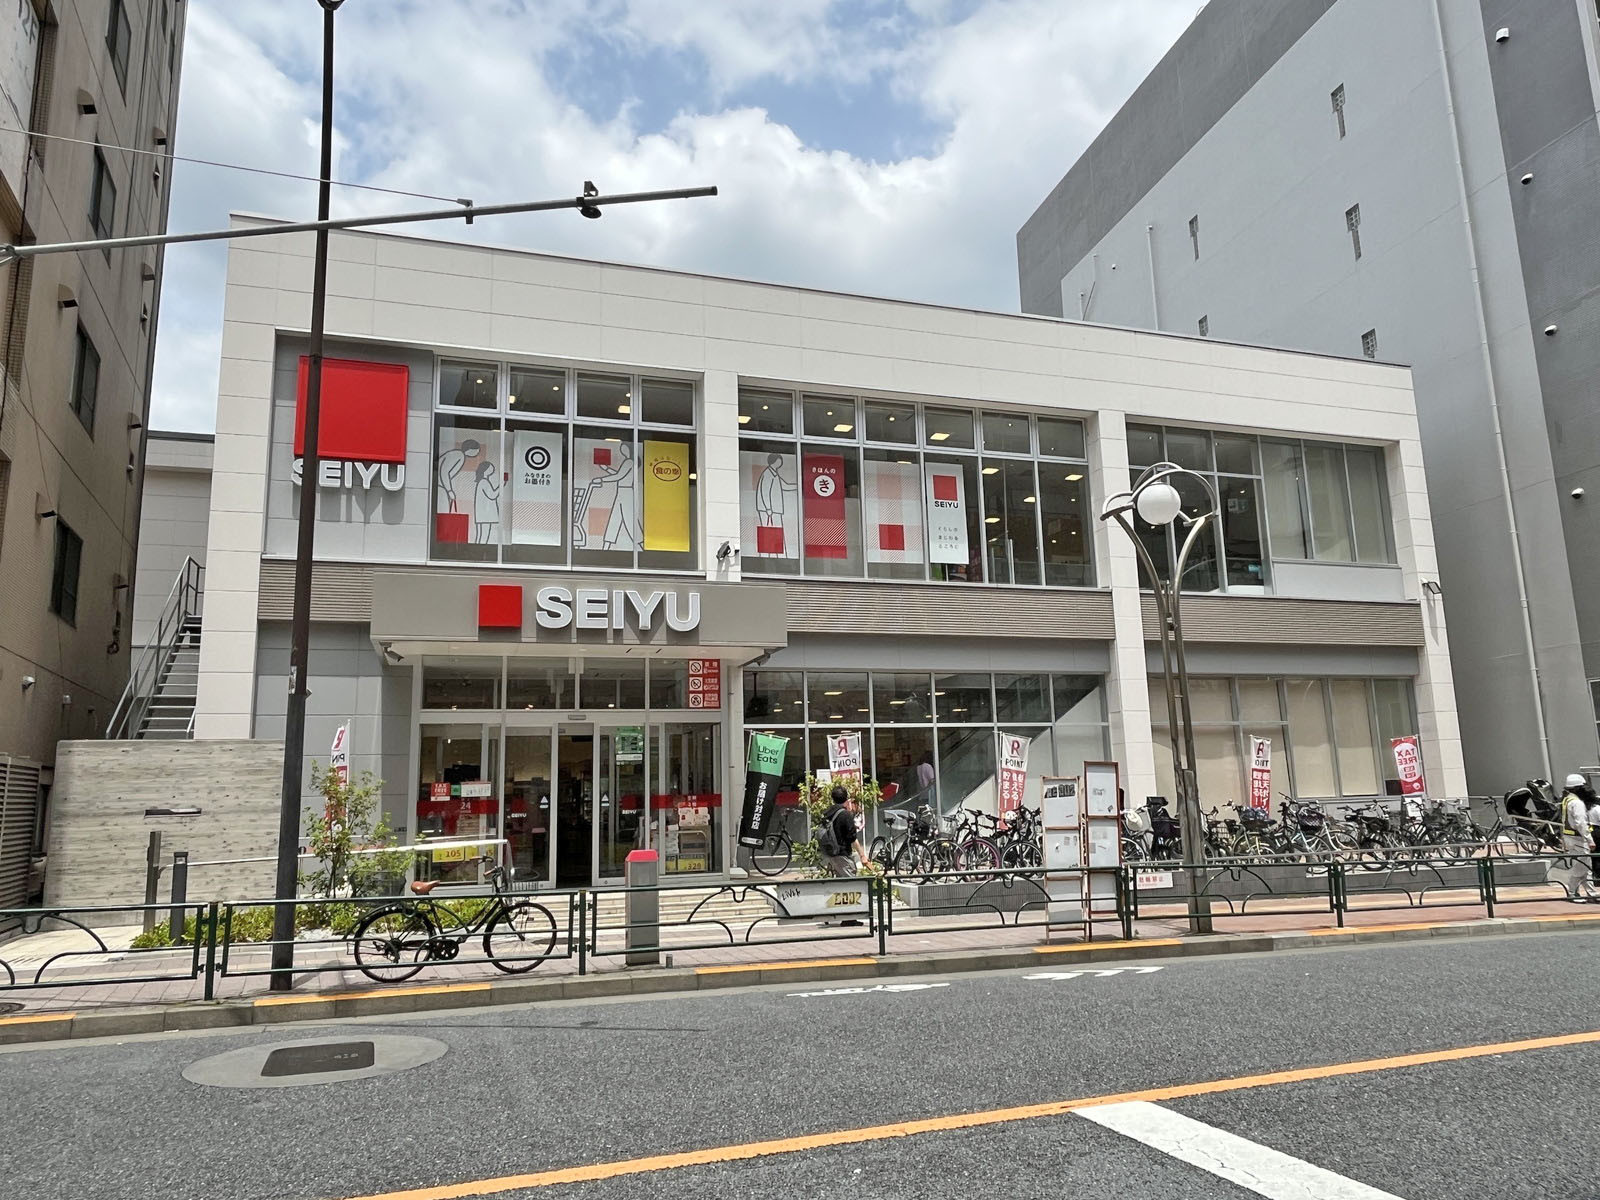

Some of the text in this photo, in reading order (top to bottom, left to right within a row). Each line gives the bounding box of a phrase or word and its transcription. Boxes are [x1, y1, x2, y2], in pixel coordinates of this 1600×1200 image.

[818, 478, 830, 493] き
[934, 500, 959, 508] SEIYU
[535, 586, 701, 632] SEIYU
[758, 745, 779, 756] Uber
[757, 754, 778, 764] Eats
[1005, 758, 1024, 769] POINT
